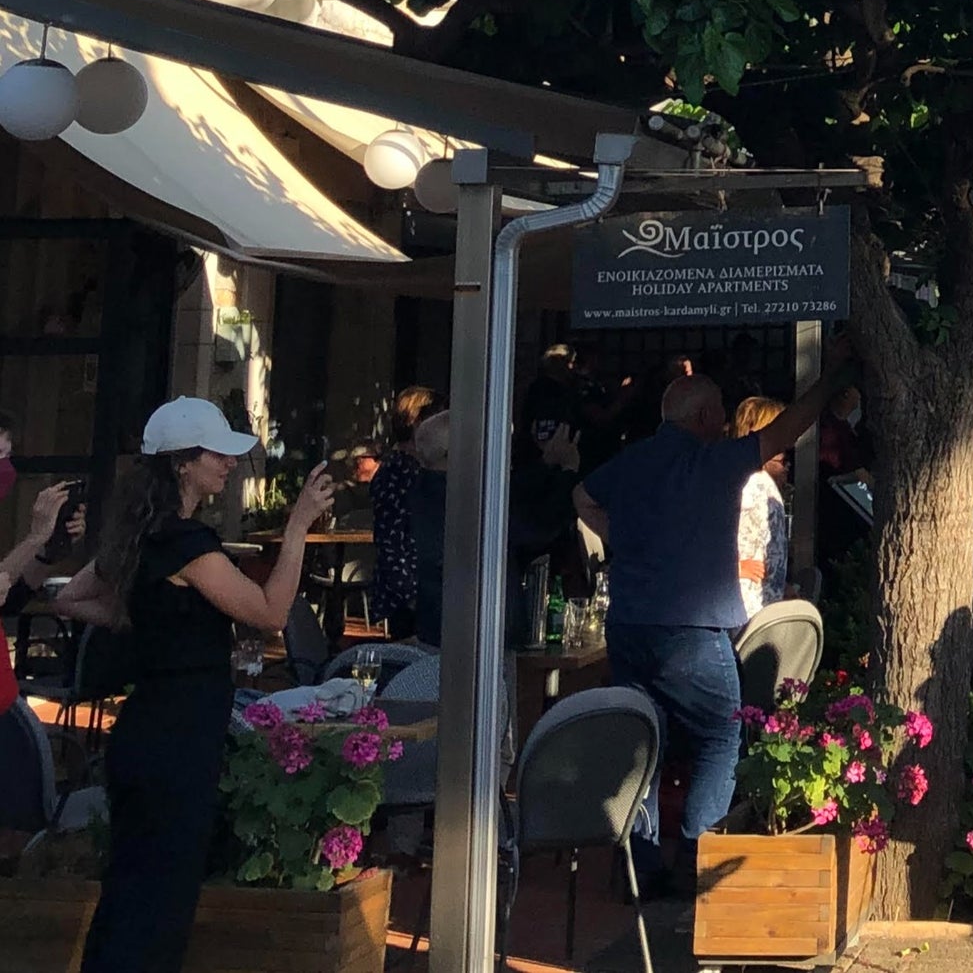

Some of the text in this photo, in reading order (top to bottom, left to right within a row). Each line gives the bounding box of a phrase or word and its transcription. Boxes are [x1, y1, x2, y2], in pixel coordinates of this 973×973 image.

[597, 264, 825, 283] ΕΝΟΙΚΙΑΖΟΜΕΝΑ ΔΙΑΜΕΡΙΣΜΑΤΑ
[632, 279, 789, 296] HOLIDAY APARTMENTS
[584, 305, 732, 319] www.maistros-kardamyli.gr
[741, 303, 761, 314] Tel.
[765, 302, 800, 314] 27210
[802, 301, 837, 313] 73286
